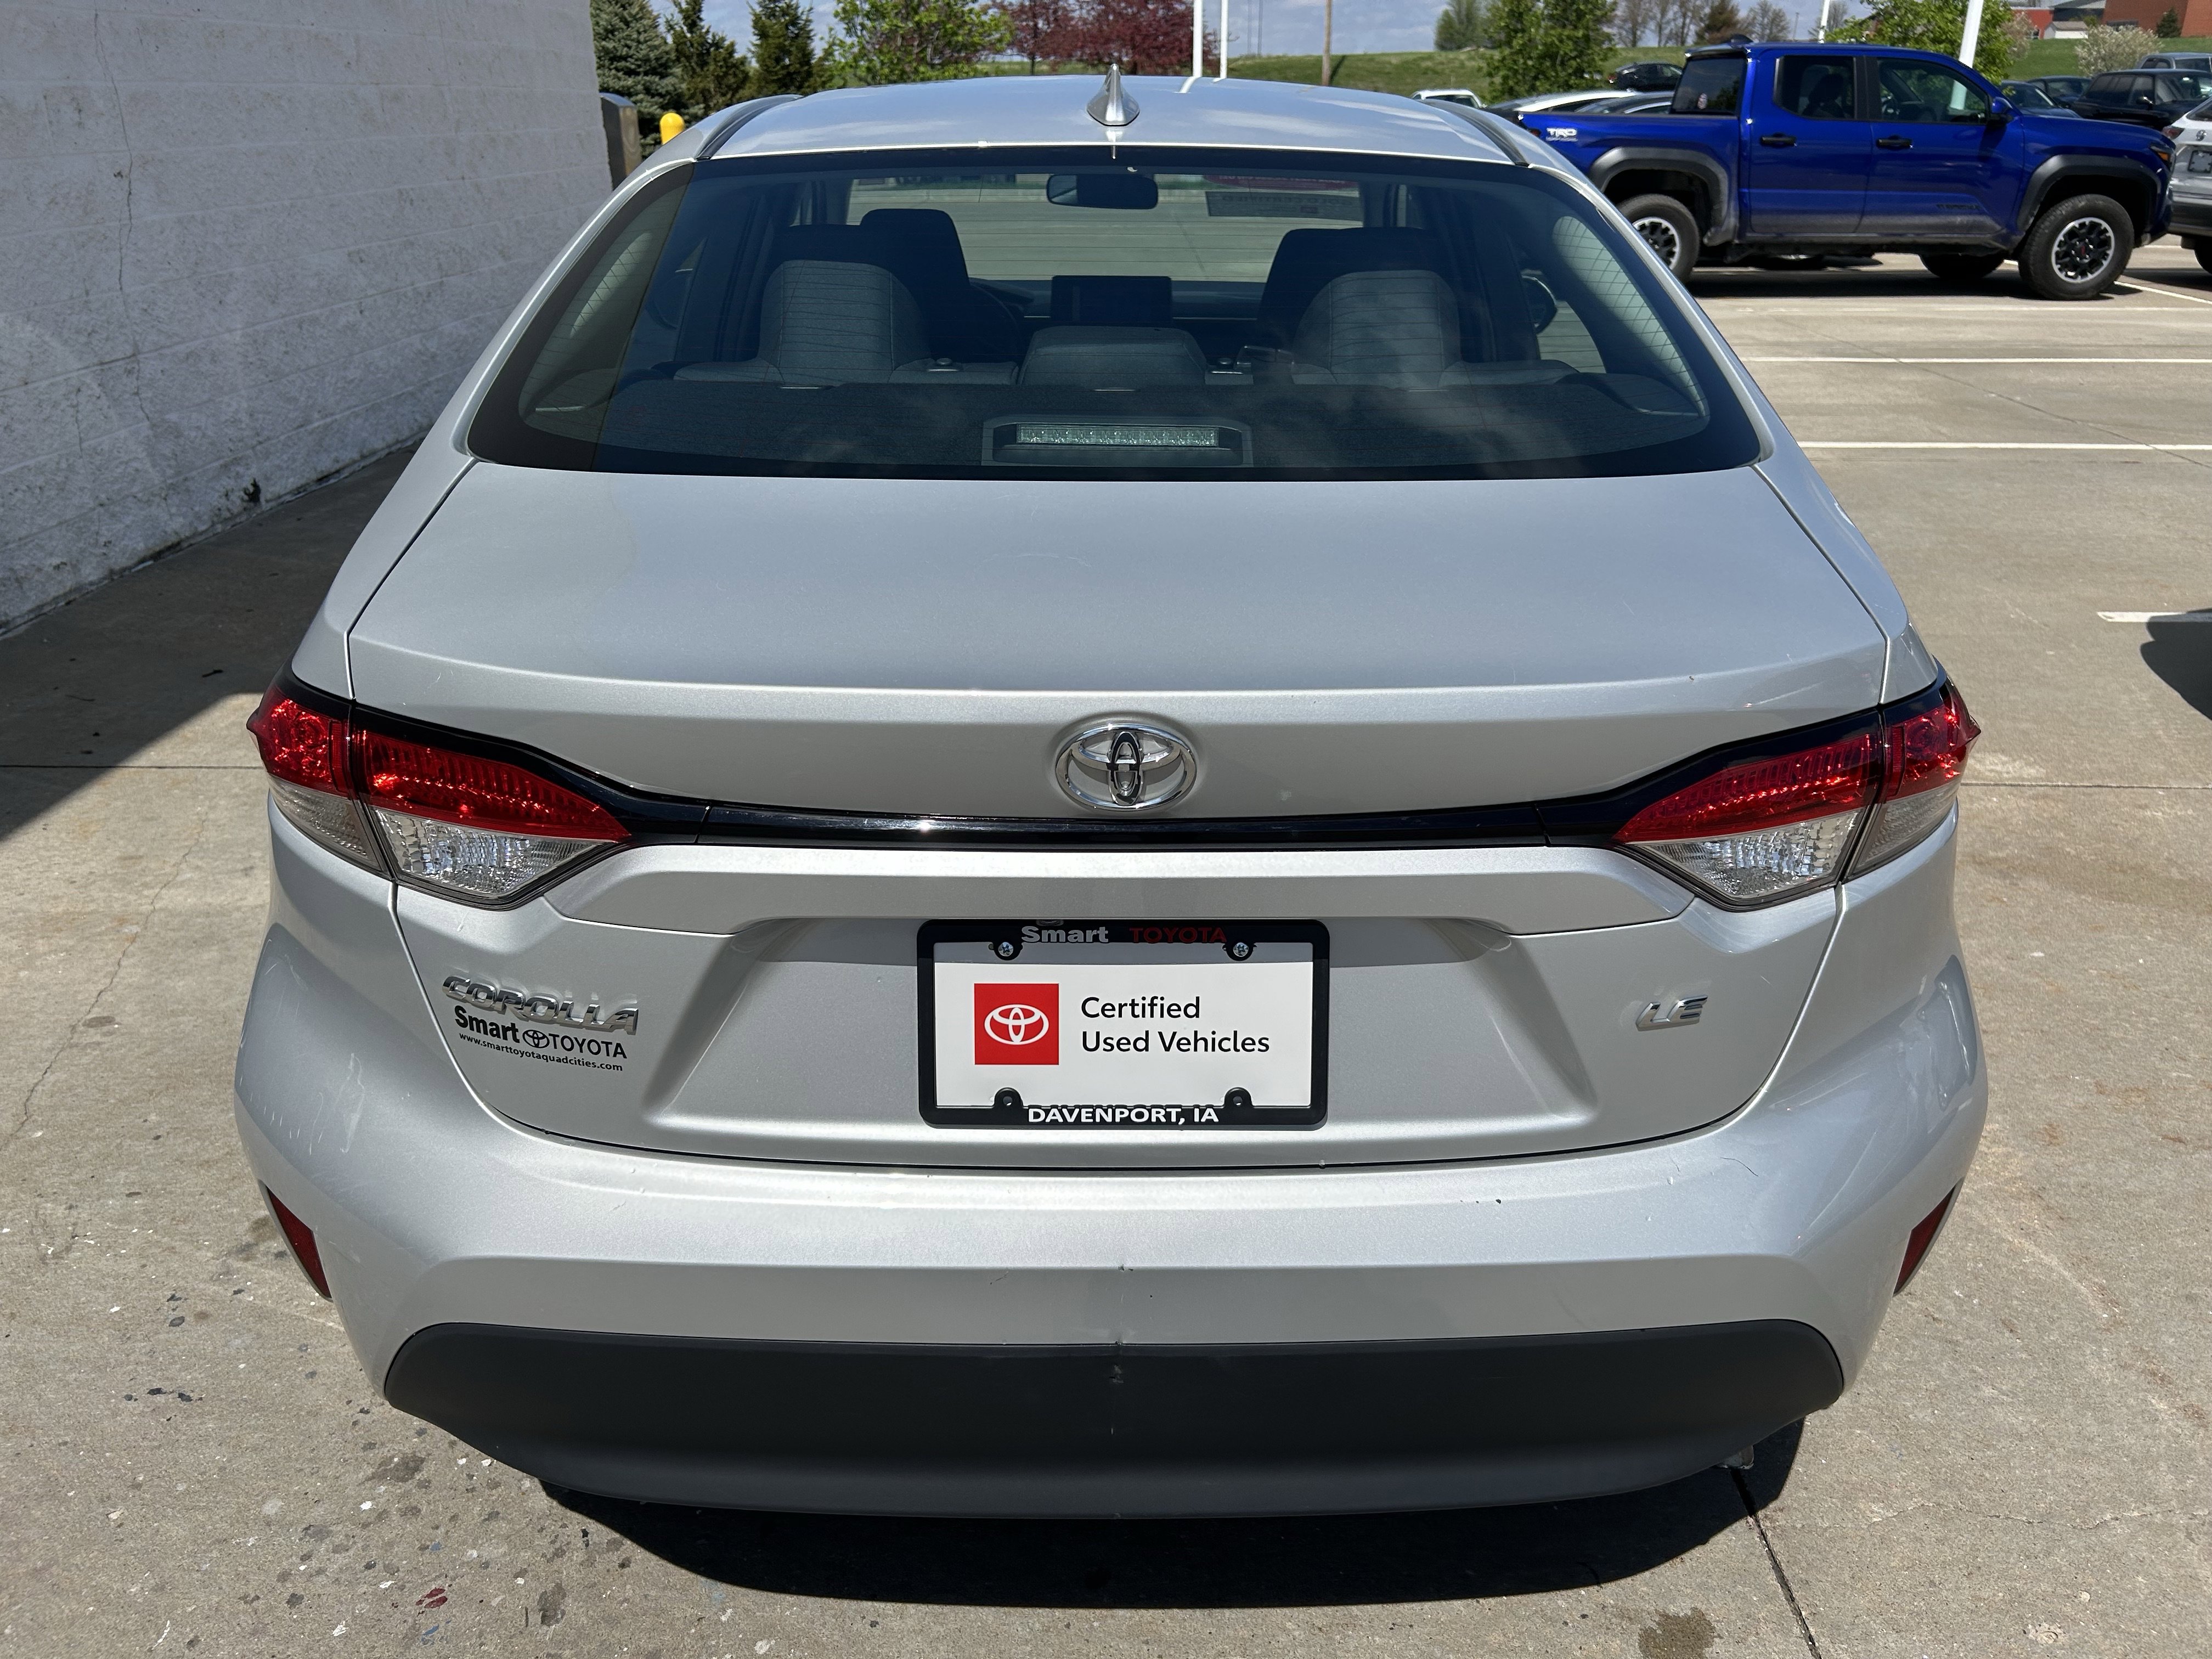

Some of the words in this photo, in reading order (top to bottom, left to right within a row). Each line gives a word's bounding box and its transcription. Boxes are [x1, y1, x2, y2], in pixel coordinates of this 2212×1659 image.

[1547, 127, 1577, 138] TRD
[1022, 926, 1109, 943] Smart
[1129, 927, 1227, 943] TOYOTA
[442, 975, 639, 1035] COROLLA
[1081, 996, 1200, 1018] Certified
[1635, 994, 1708, 1031] LE
[454, 1005, 520, 1043] Smart
[548, 1034, 627, 1059] TOYOTA
[1082, 1030, 1149, 1052] Used
[1158, 1030, 1269, 1052] Vehicles
[459, 1032, 623, 1071] www.smarttoyotaquadcities.com
[1028, 1108, 1185, 1125] DAVENPORT,
[1194, 1108, 1219, 1122] IA
